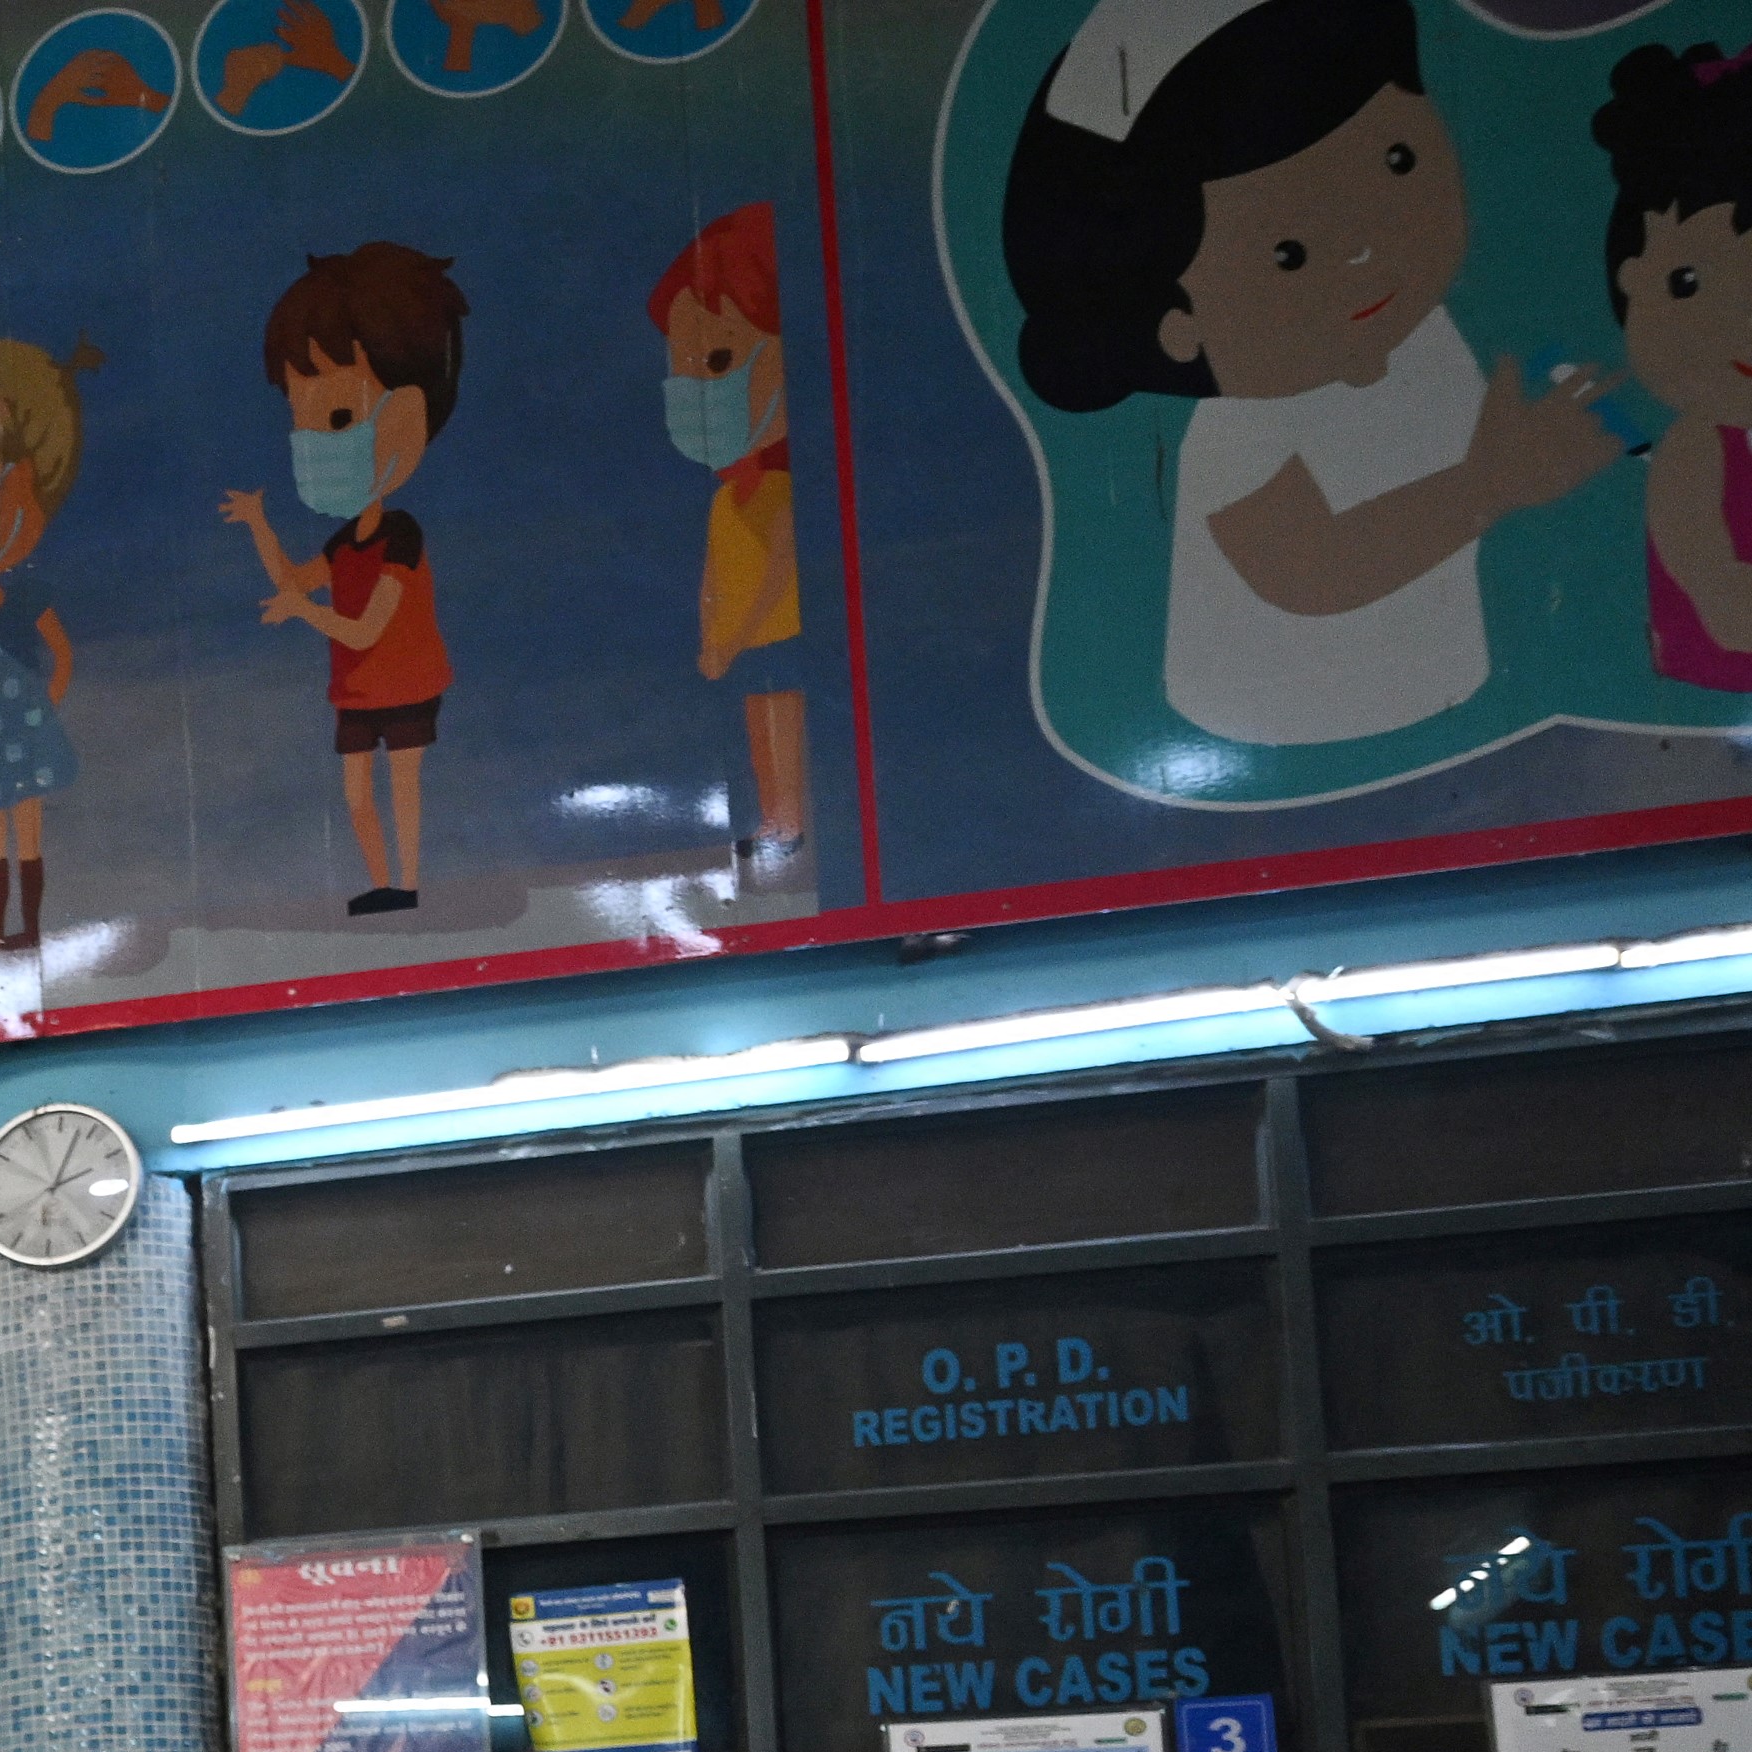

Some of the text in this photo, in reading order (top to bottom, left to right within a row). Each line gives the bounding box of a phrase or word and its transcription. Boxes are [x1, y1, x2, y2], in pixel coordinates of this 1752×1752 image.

[922, 1337, 1111, 1395] O. P. D.
[853, 1385, 1190, 1448] REGISTRATION
[871, 1555, 1190, 1652] नये रोगी
[1438, 1608, 1752, 1678] NEW CASE
[867, 1646, 1211, 1715] NEW CASES
